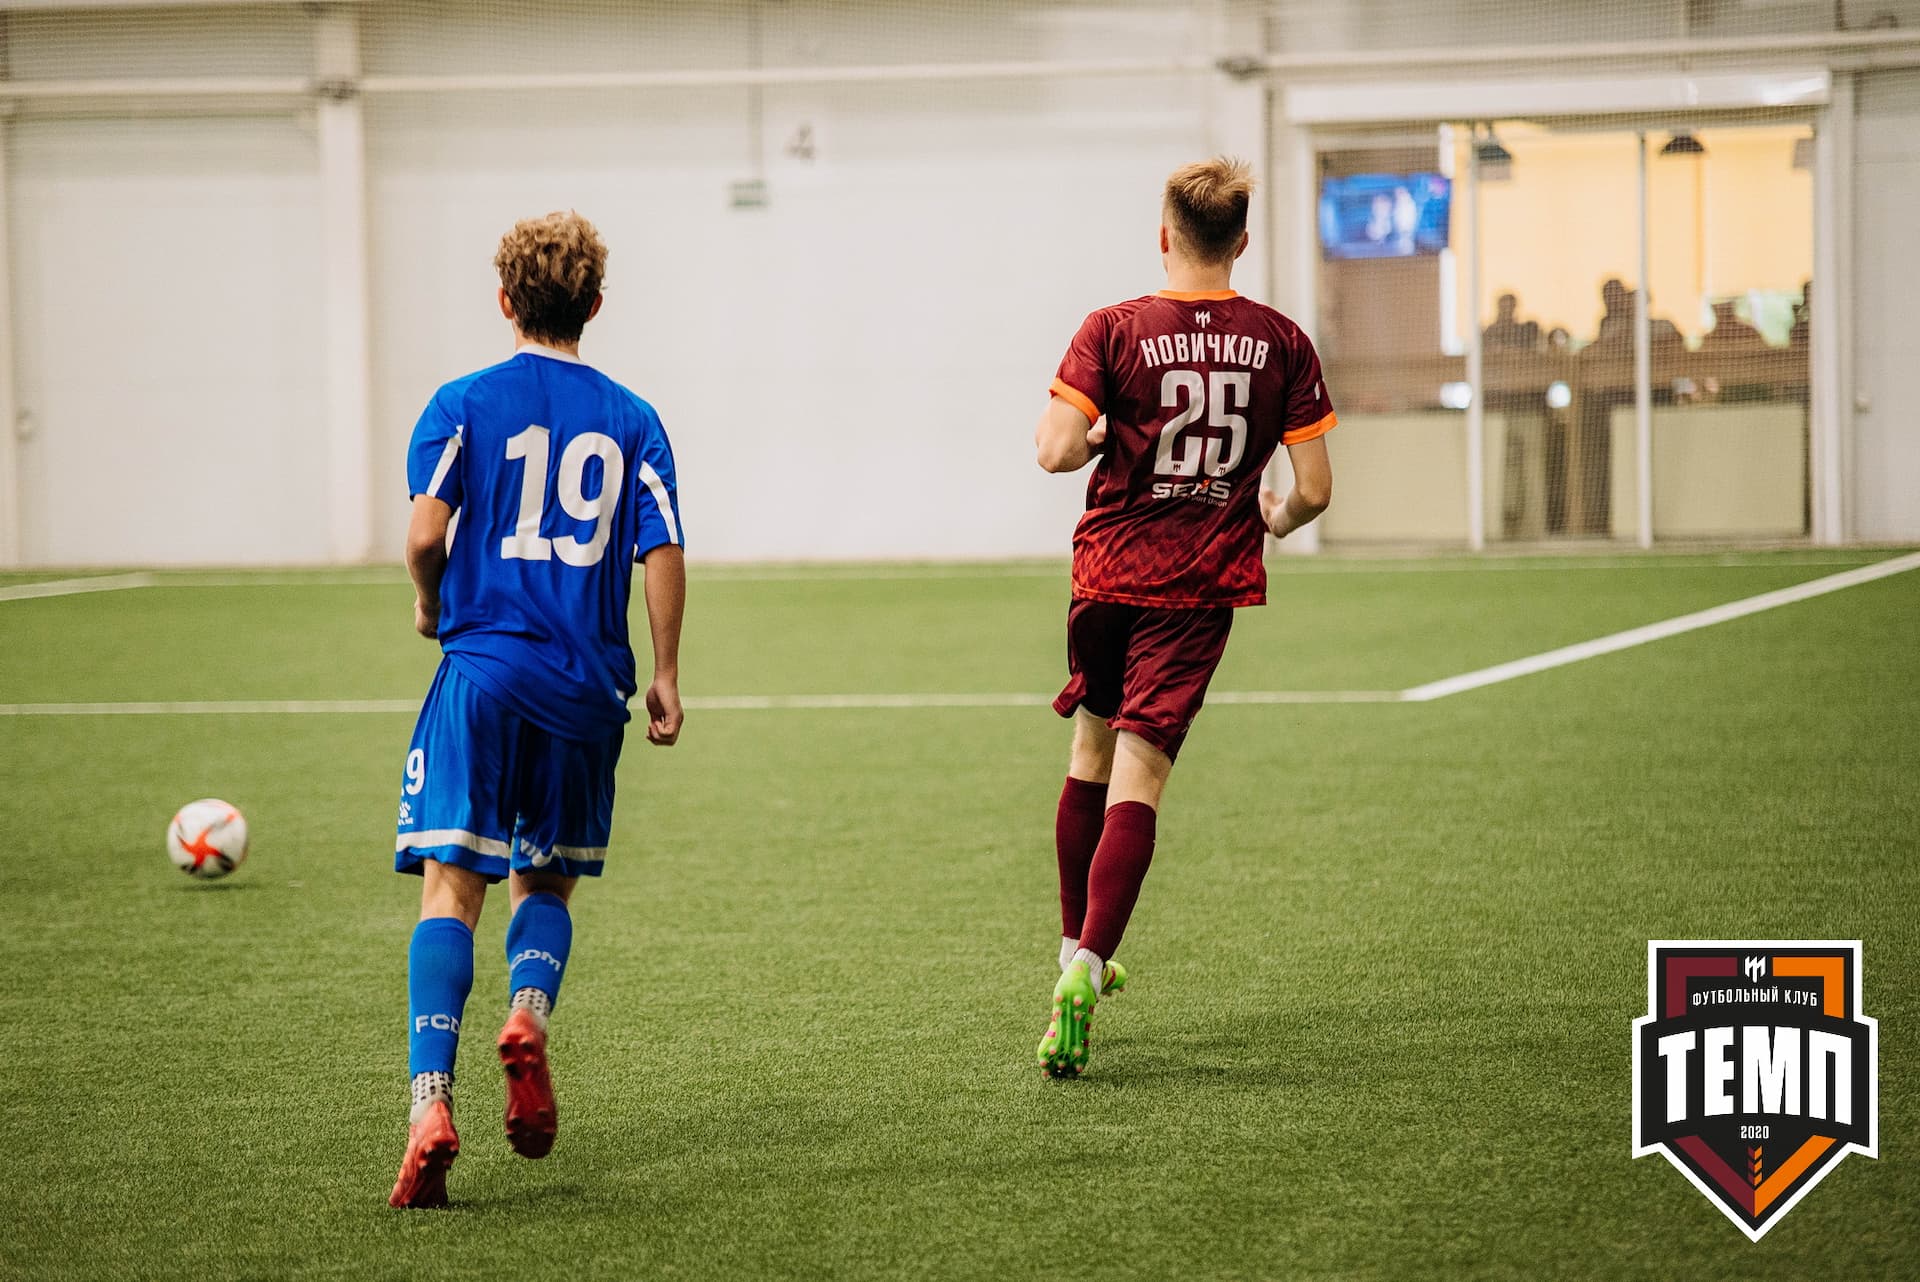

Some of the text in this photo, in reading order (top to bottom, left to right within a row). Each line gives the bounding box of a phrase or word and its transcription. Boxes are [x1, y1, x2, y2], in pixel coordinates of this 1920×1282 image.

[1140, 333, 1269, 369] НОВИЧКОВ
[1153, 370, 1251, 477] 25
[501, 424, 624, 567] 19
